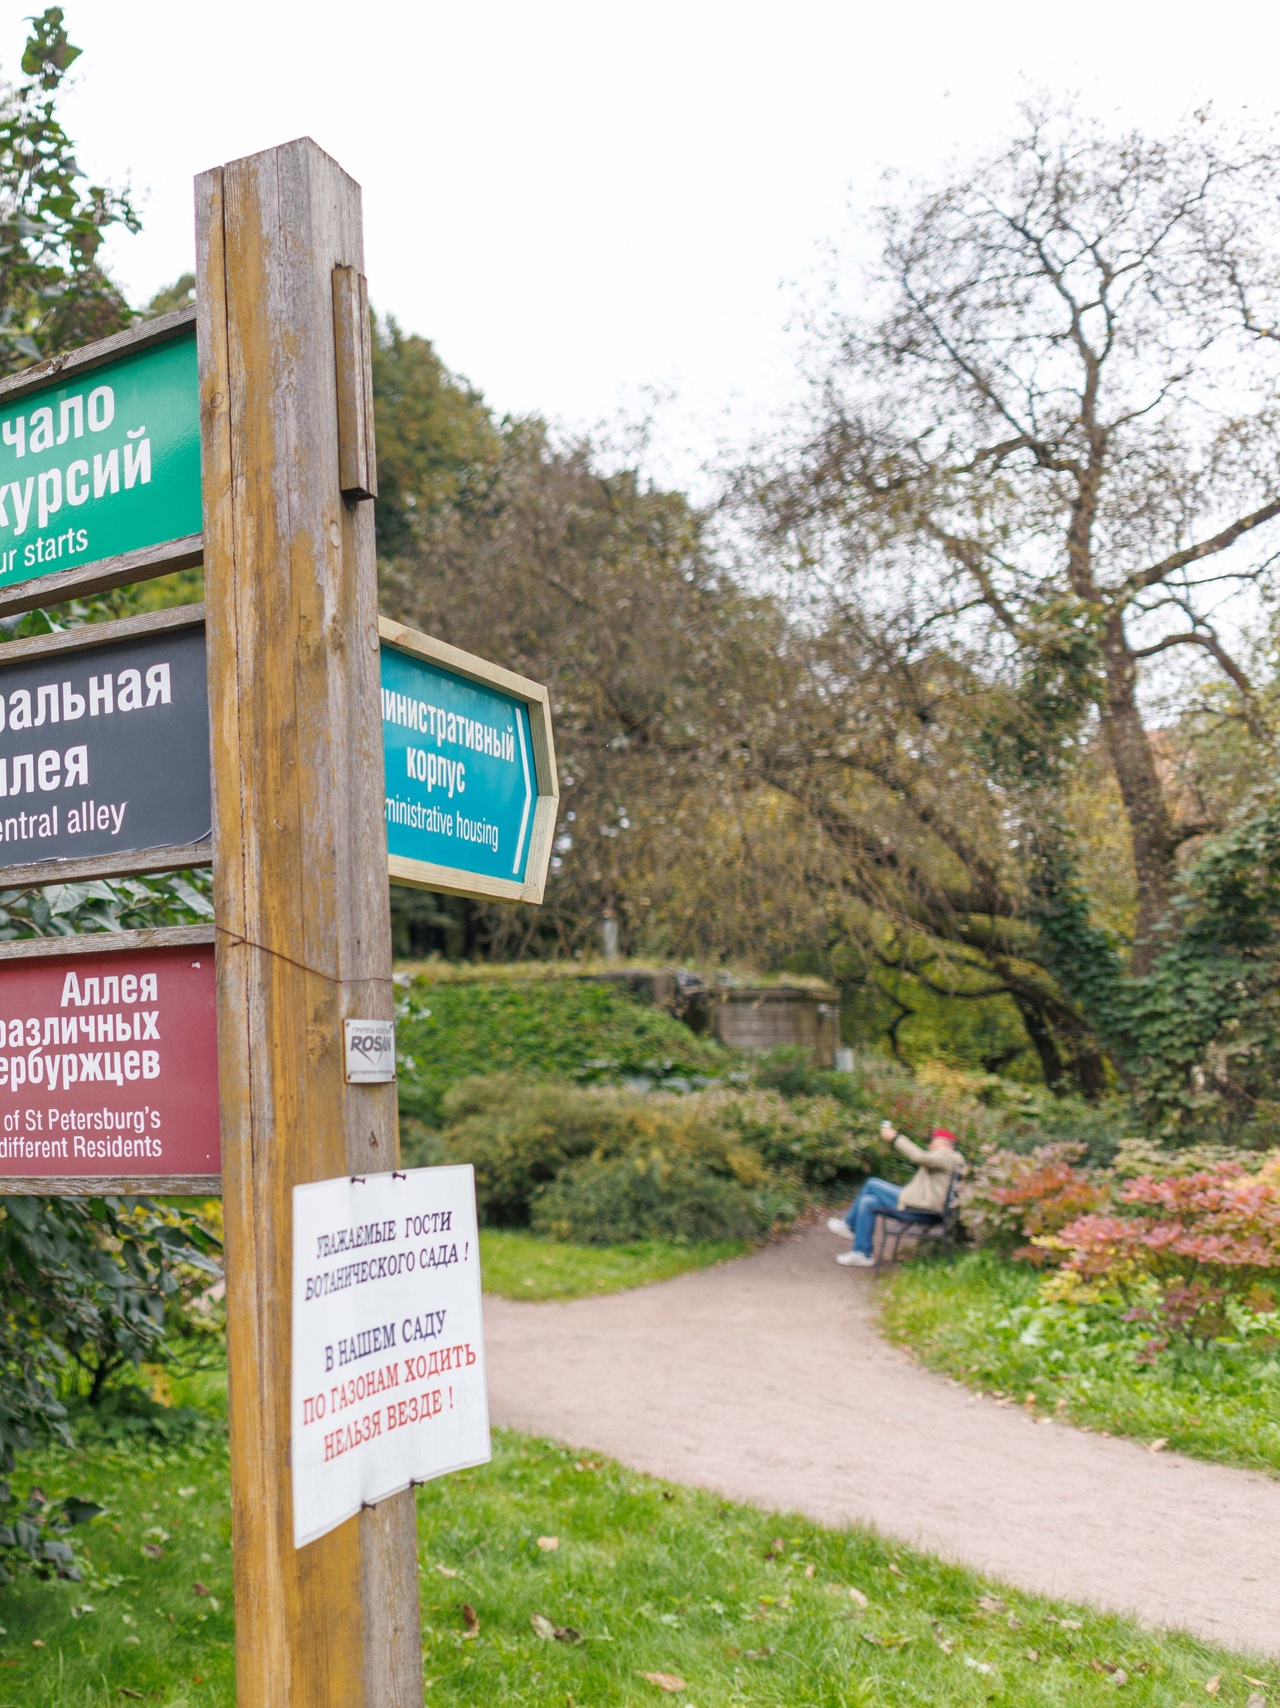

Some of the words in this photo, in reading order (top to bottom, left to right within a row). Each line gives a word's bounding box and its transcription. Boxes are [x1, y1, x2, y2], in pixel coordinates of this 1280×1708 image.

[24, 528, 89, 566] starts
[407, 746, 465, 798] корпус
[67, 800, 128, 835] alley
[456, 811, 499, 852] housing
[60, 972, 158, 1007] Аллея
[4, 1110, 20, 1132] of
[25, 1109, 43, 1131] St
[73, 1135, 162, 1158] Residents
[317, 1220, 397, 1258] УВАЖАЕМЫЕ
[405, 1211, 452, 1238] ГОСТИ
[305, 1251, 415, 1301] БОТАНИЧЕСКОГО
[325, 1345, 334, 1372] В
[338, 1323, 396, 1366] НАШЕМ
[402, 1310, 447, 1343] САДУ
[303, 1393, 326, 1425] ПО
[331, 1363, 399, 1413] ГАЗОНАМ
[404, 1343, 476, 1383] ХОДИТЬ
[324, 1410, 382, 1462] НЕЛЬЗЯ
